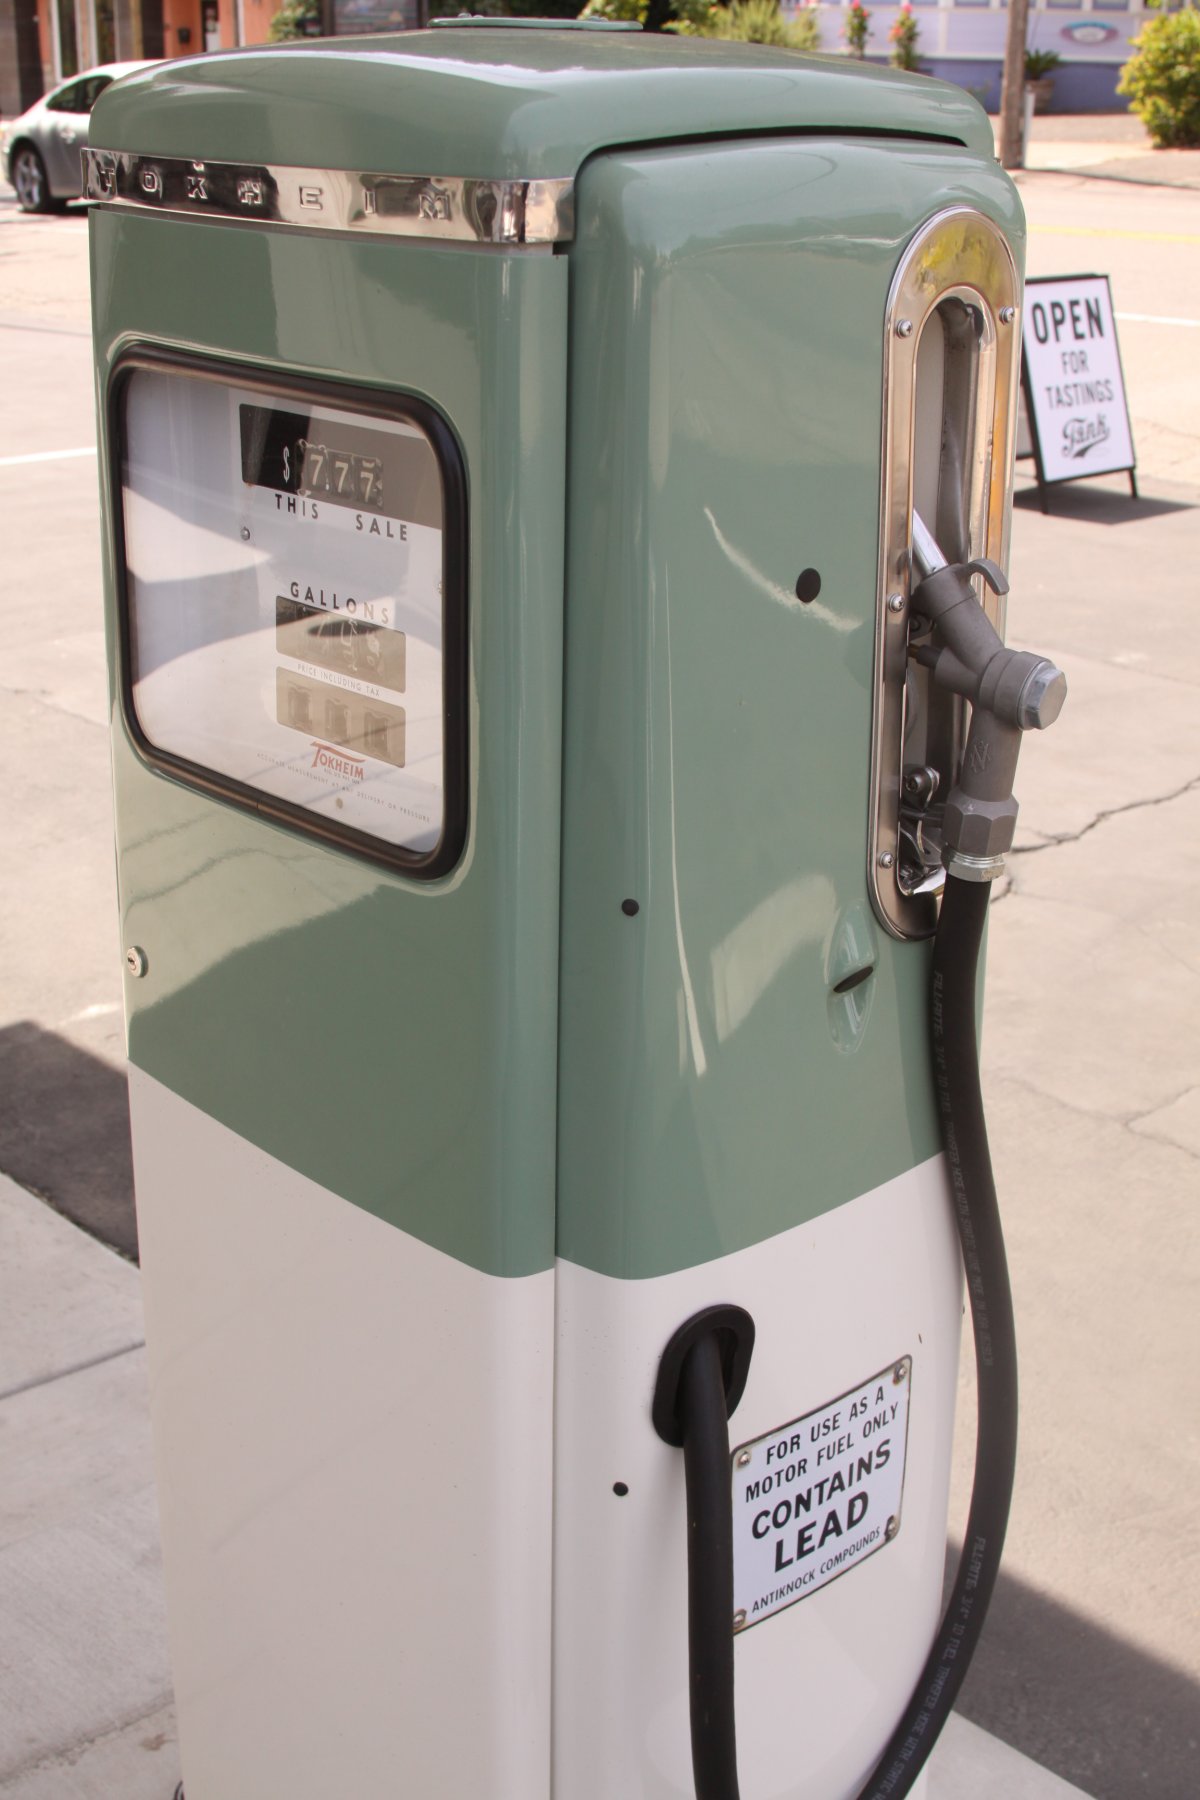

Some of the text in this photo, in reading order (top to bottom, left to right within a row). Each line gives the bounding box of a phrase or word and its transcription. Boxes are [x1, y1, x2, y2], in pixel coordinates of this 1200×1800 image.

[99, 167, 453, 221] TOKHEIM
[1032, 297, 1104, 344] OPEN
[1061, 350, 1089, 375] FOR
[1045, 379, 1114, 410] TASTINGS
[274, 493, 408, 541] THIS SALE
[290, 582, 389, 624] GALLONS
[297, 663, 380, 697] PRICE INCLUDING TAX
[310, 741, 366, 780] TOKHEIM
[766, 1386, 884, 1465] FOR USE AS A
[745, 1402, 899, 1503] MOTOR FUEL ONLY
[752, 1438, 891, 1540] CONTAINS
[774, 1491, 869, 1573] LEAD
[751, 1526, 880, 1613] ANTIKNOCK COMPOUNDS
